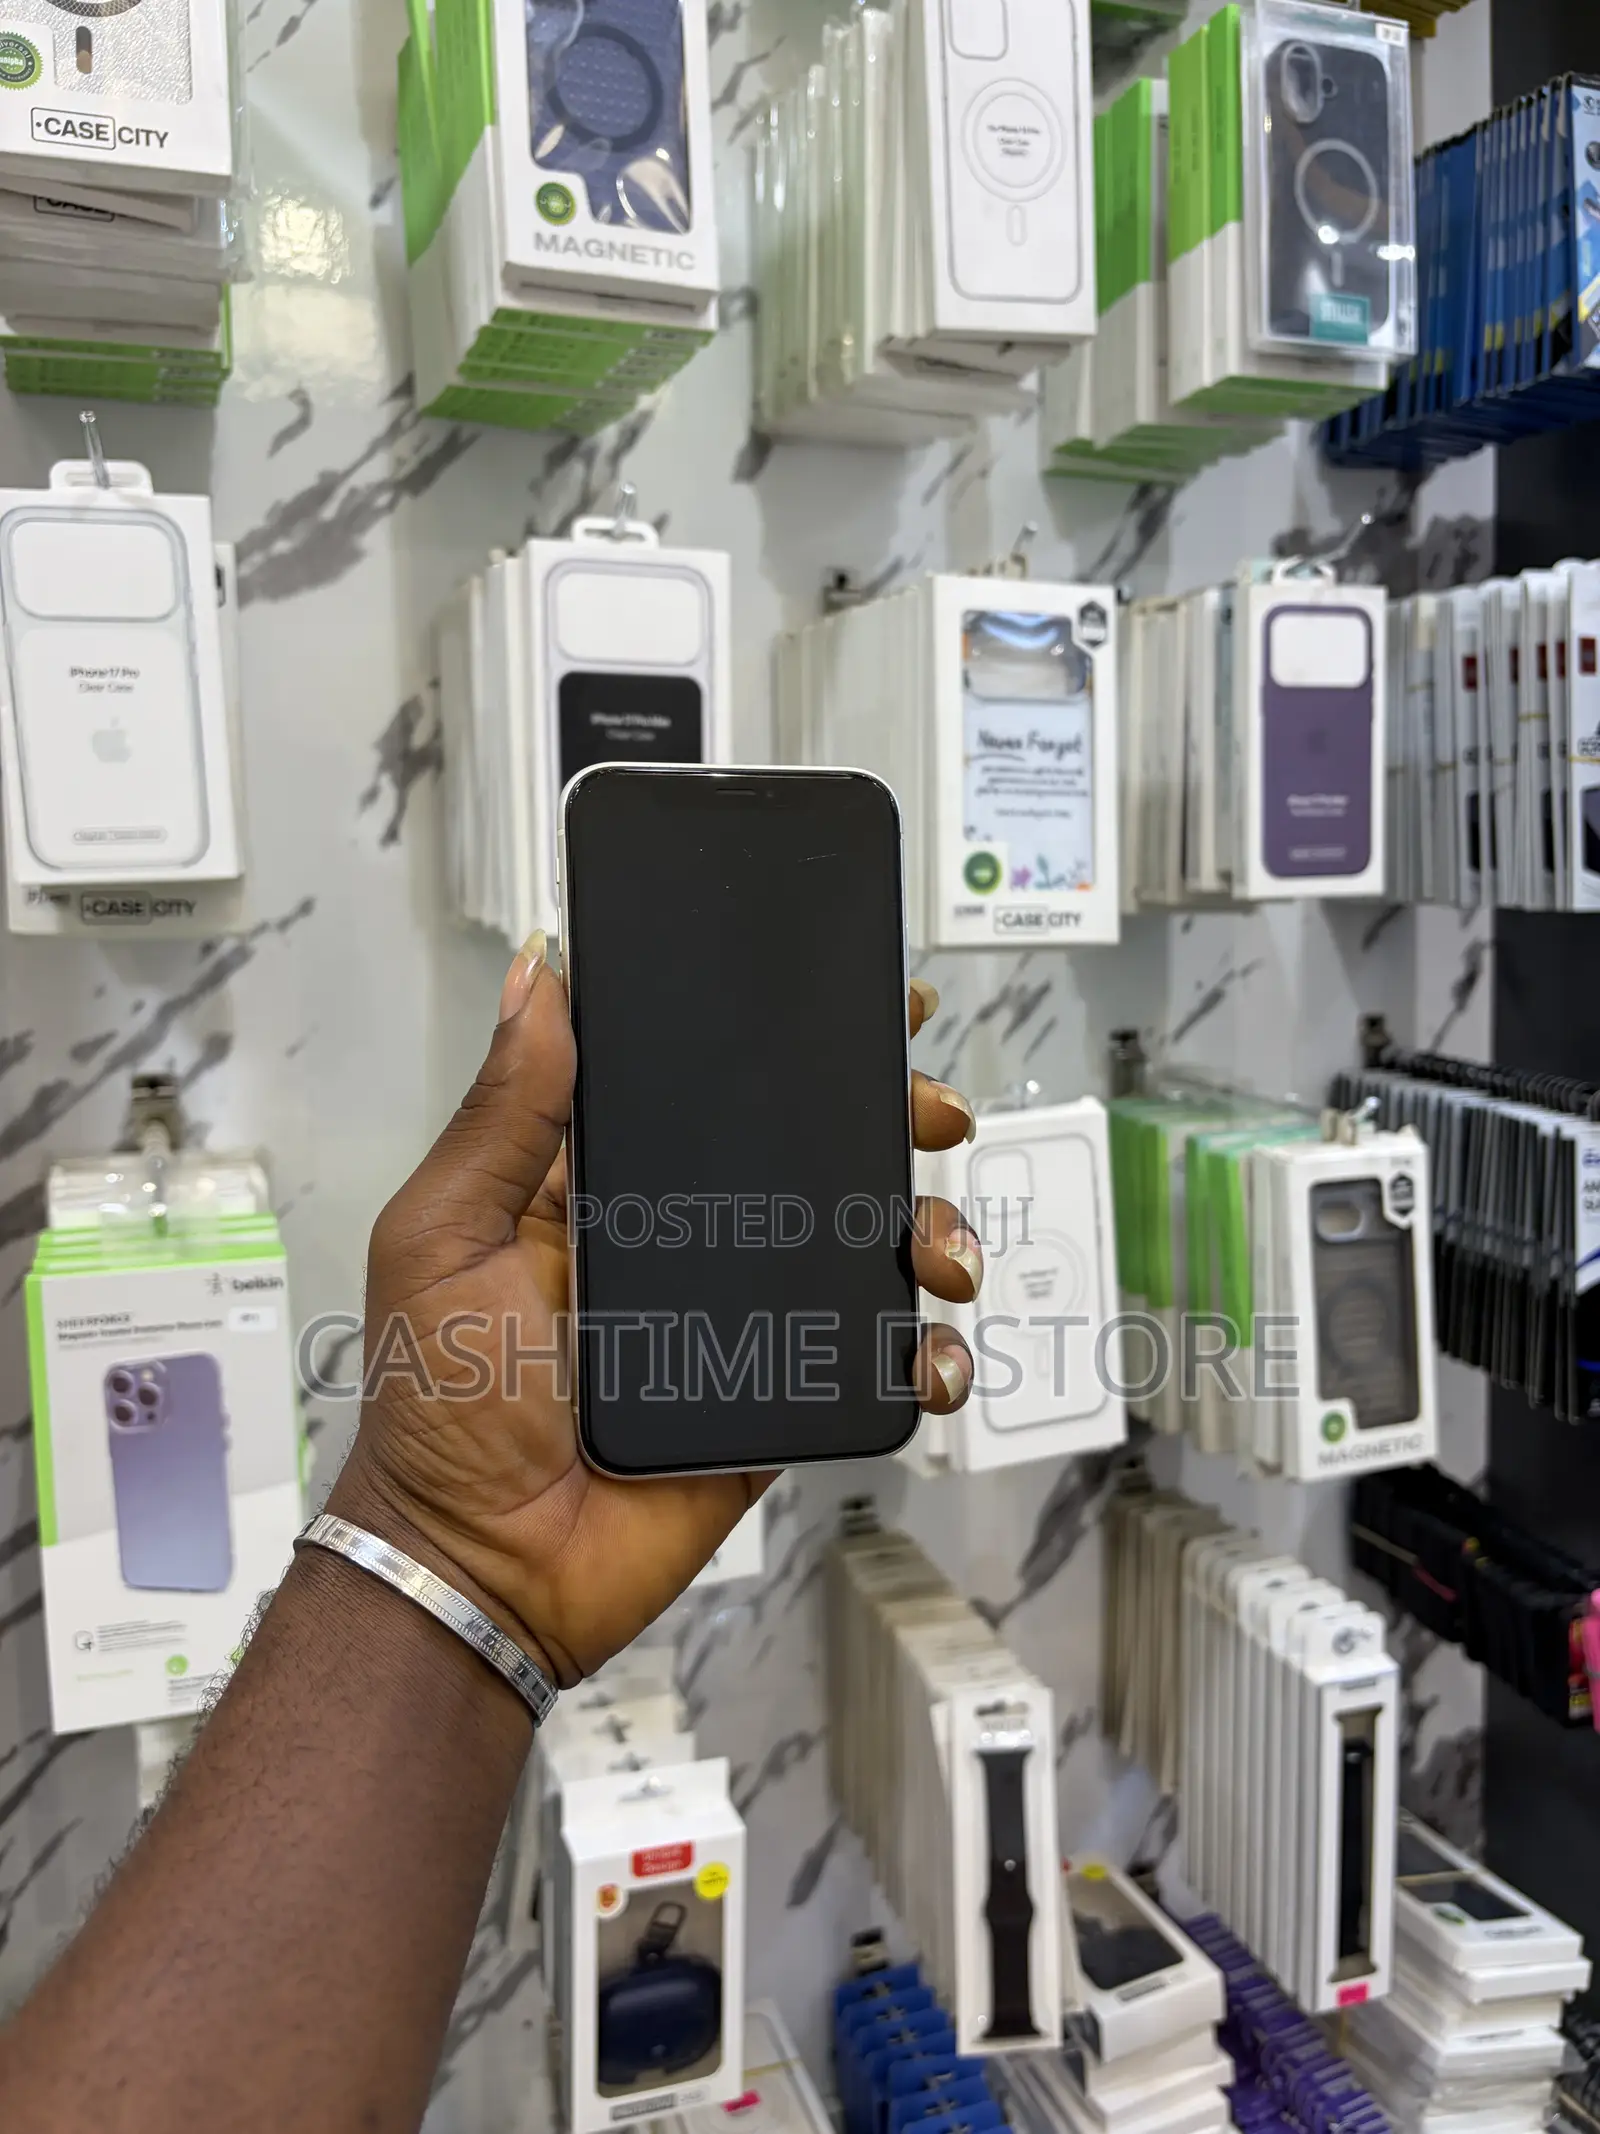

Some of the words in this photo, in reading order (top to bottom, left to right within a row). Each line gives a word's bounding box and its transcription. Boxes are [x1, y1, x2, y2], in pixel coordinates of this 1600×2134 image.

[43, 117, 110, 142] CASE
[117, 126, 169, 149] CITY
[533, 231, 696, 271] MAGNETIC
[152, 899, 197, 917] CITY
[1001, 912, 1043, 928] CASE
[1047, 912, 1082, 928] CITY
[1317, 1434, 1423, 1468] MAGNETIC
